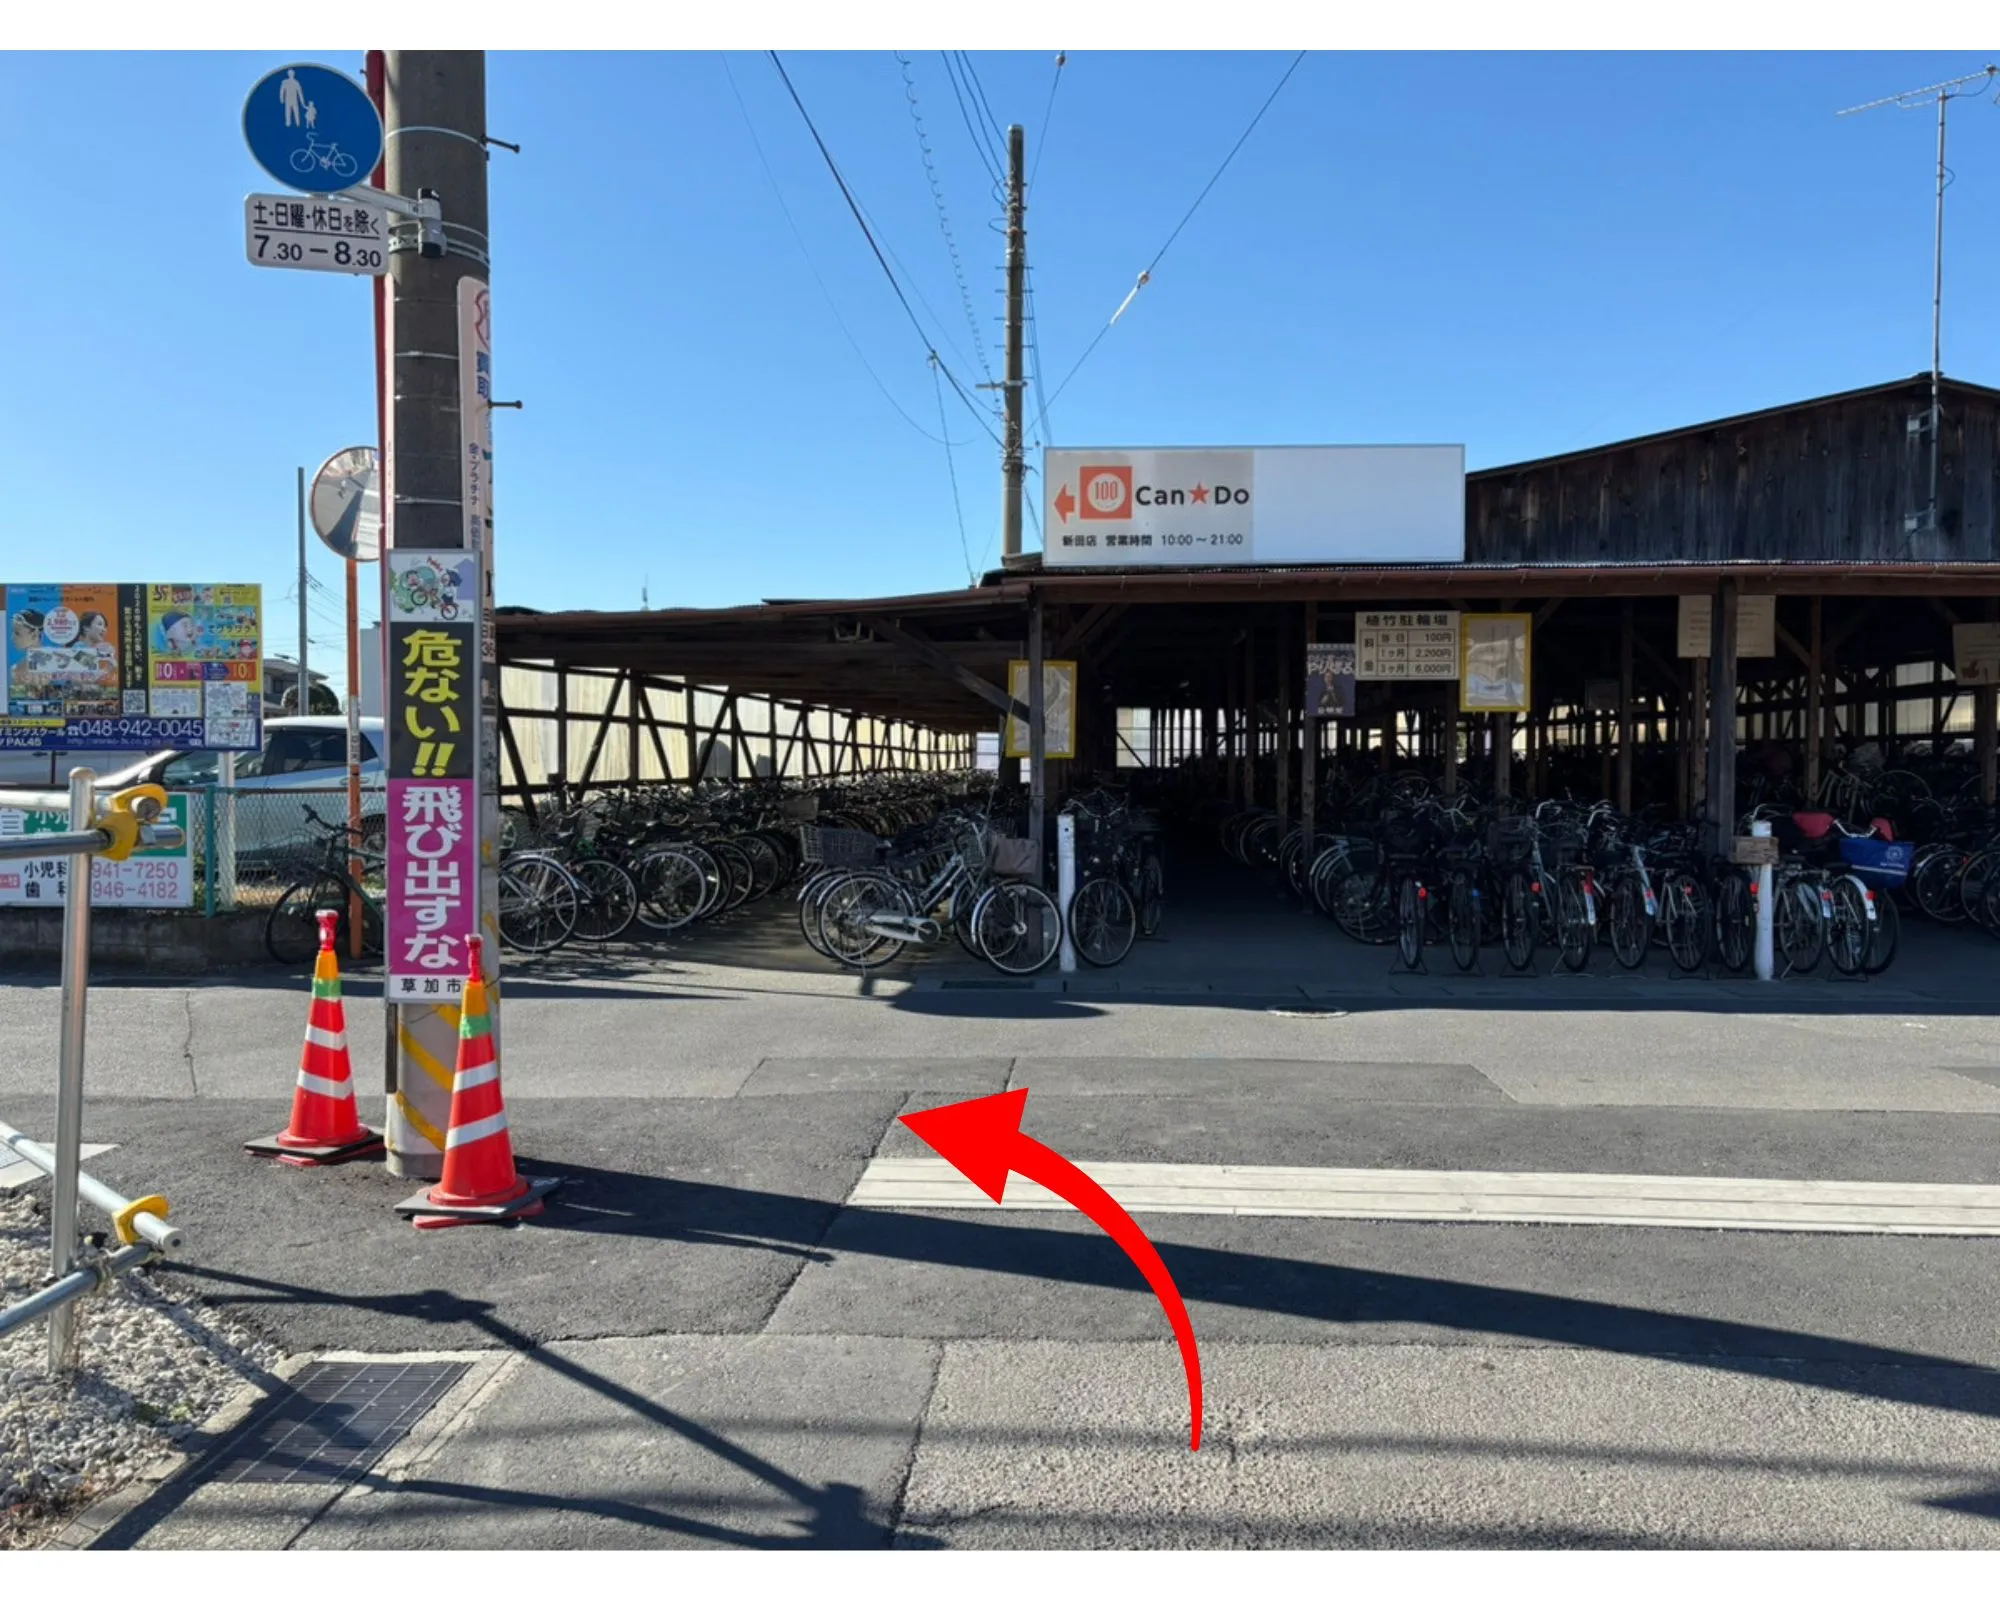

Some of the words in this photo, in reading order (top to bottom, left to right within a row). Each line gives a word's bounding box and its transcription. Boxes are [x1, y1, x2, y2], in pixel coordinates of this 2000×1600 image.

[1093, 480, 1118, 501] 100
[1105, 534, 1153, 547] 営業時間
[79, 719, 204, 736] 048-942-0045
[402, 785, 463, 970] 飛び出すな
[401, 977, 462, 994] 草加市
